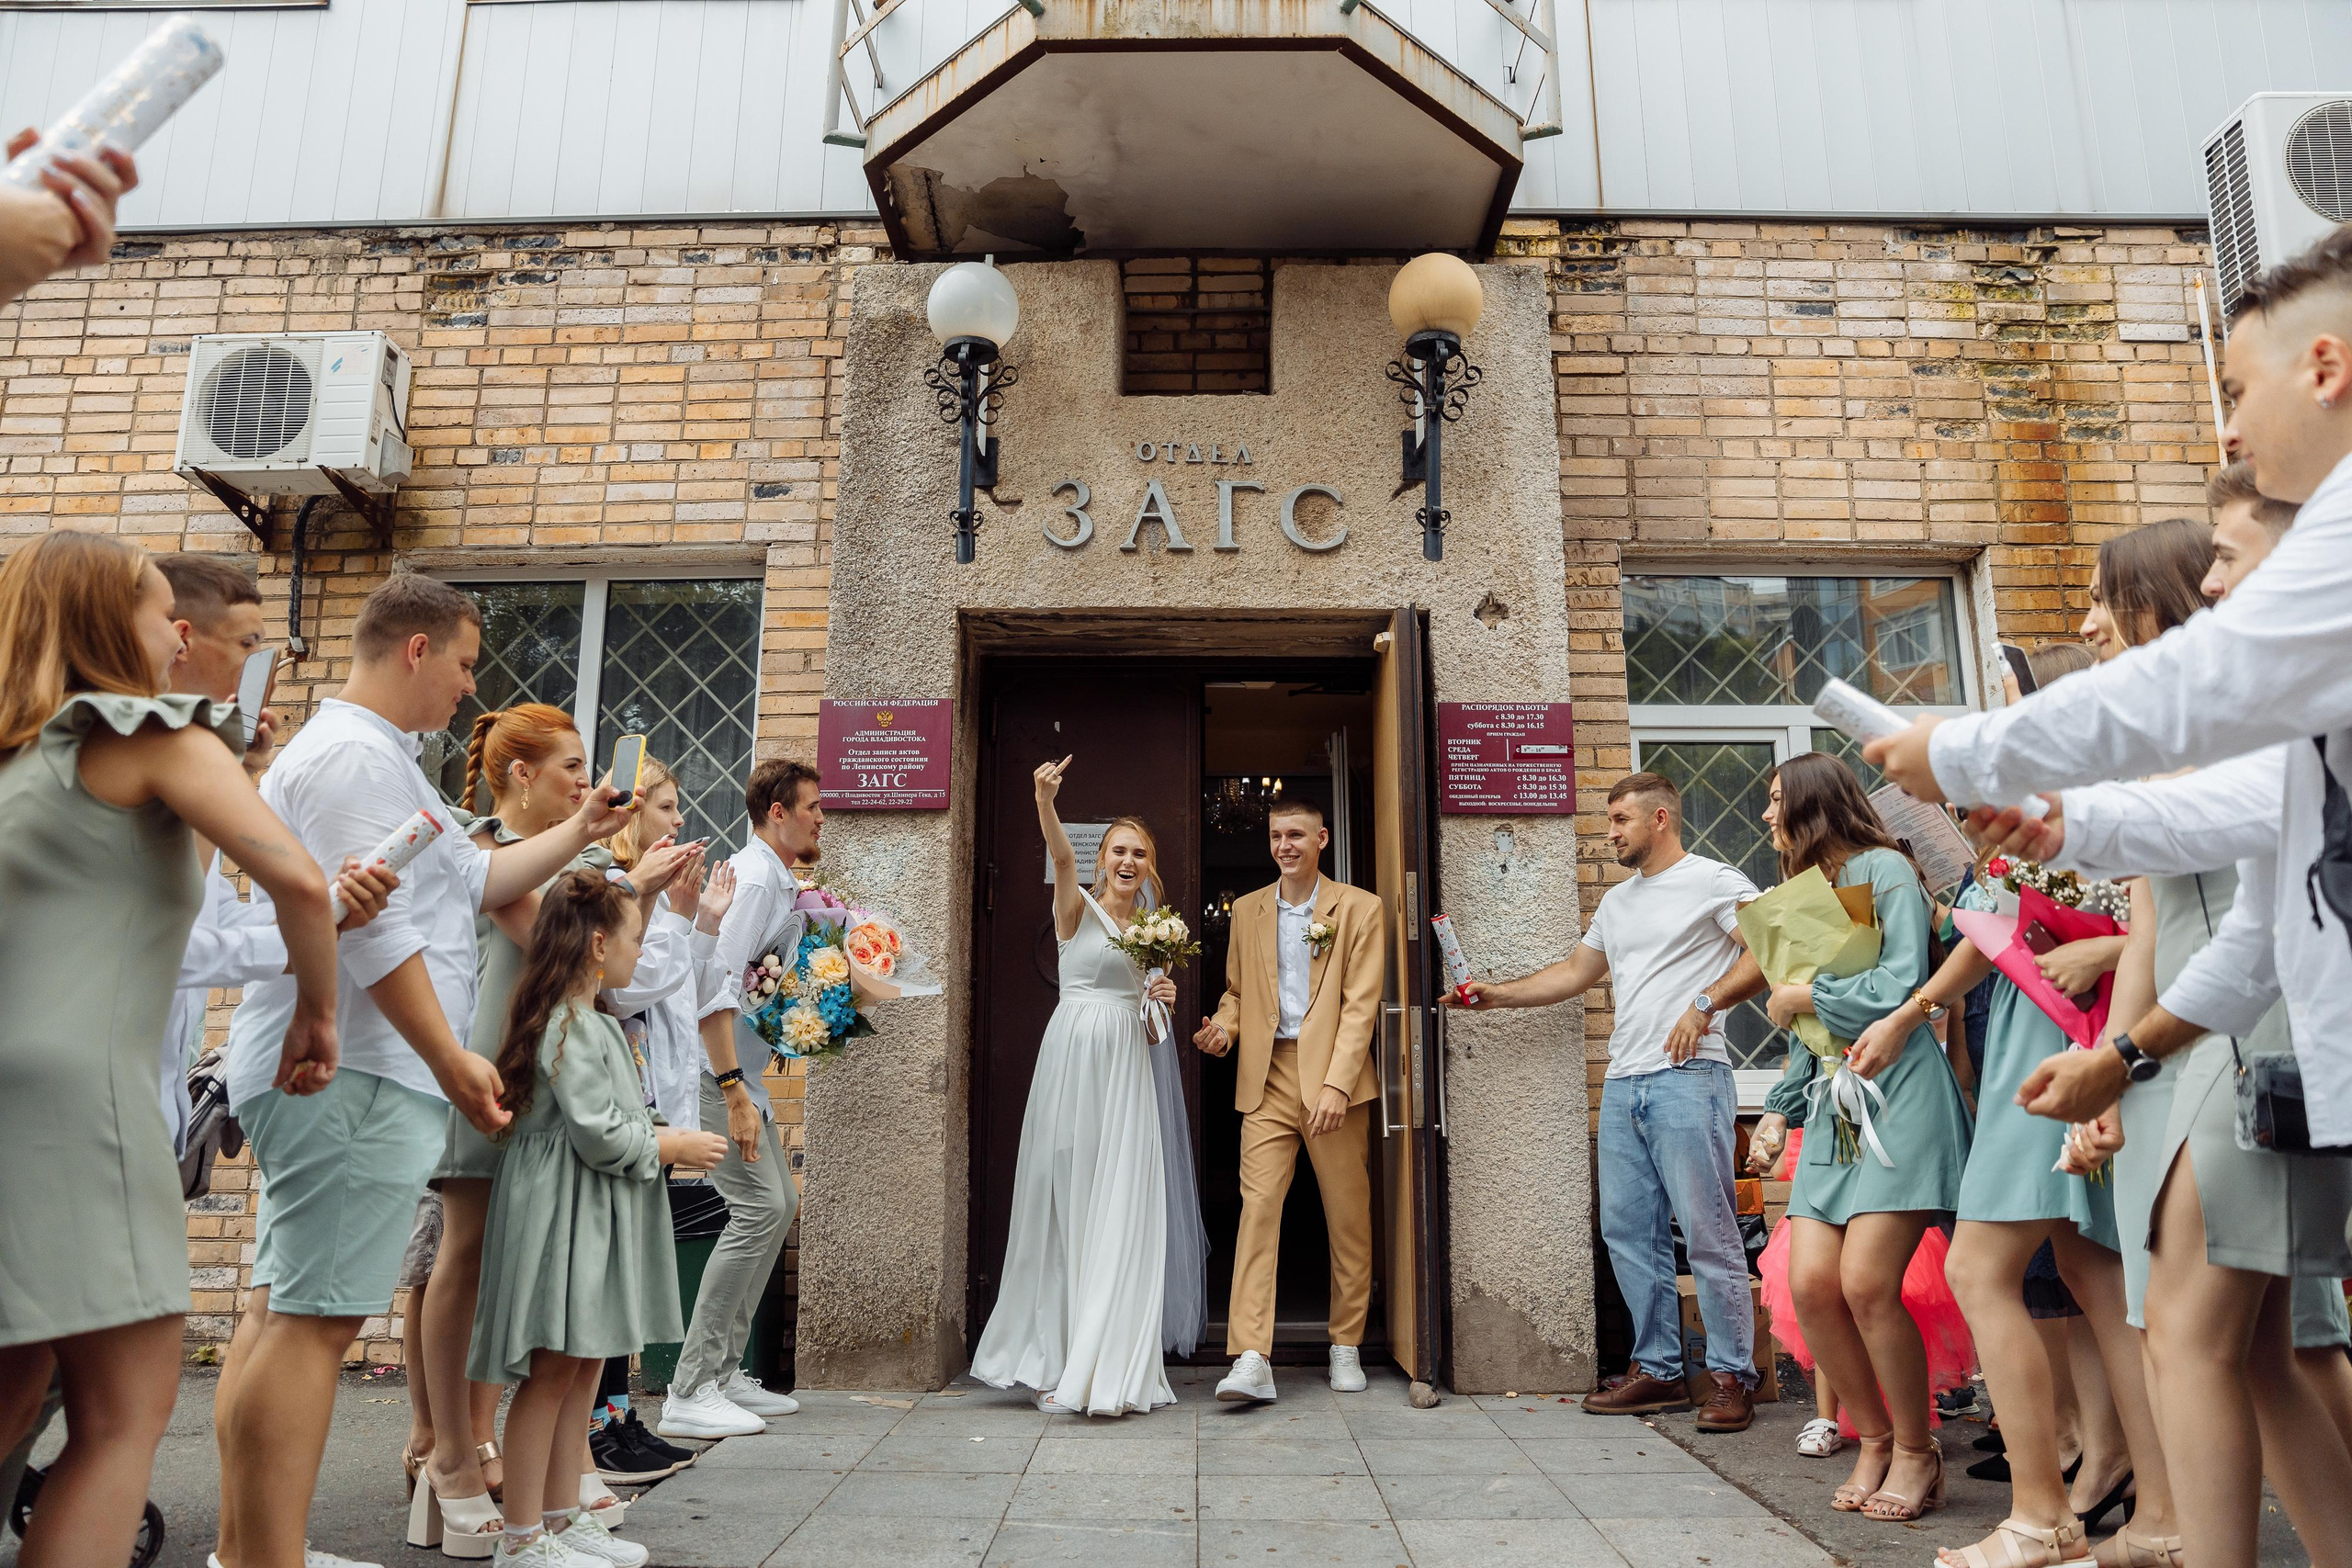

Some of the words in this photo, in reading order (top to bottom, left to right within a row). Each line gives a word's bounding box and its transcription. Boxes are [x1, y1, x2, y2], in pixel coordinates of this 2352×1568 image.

[1136, 442, 1253, 465] ОТДЕЛ
[1042, 479, 1350, 552] ЗАГС
[857, 773, 908, 787] ЗАГС
